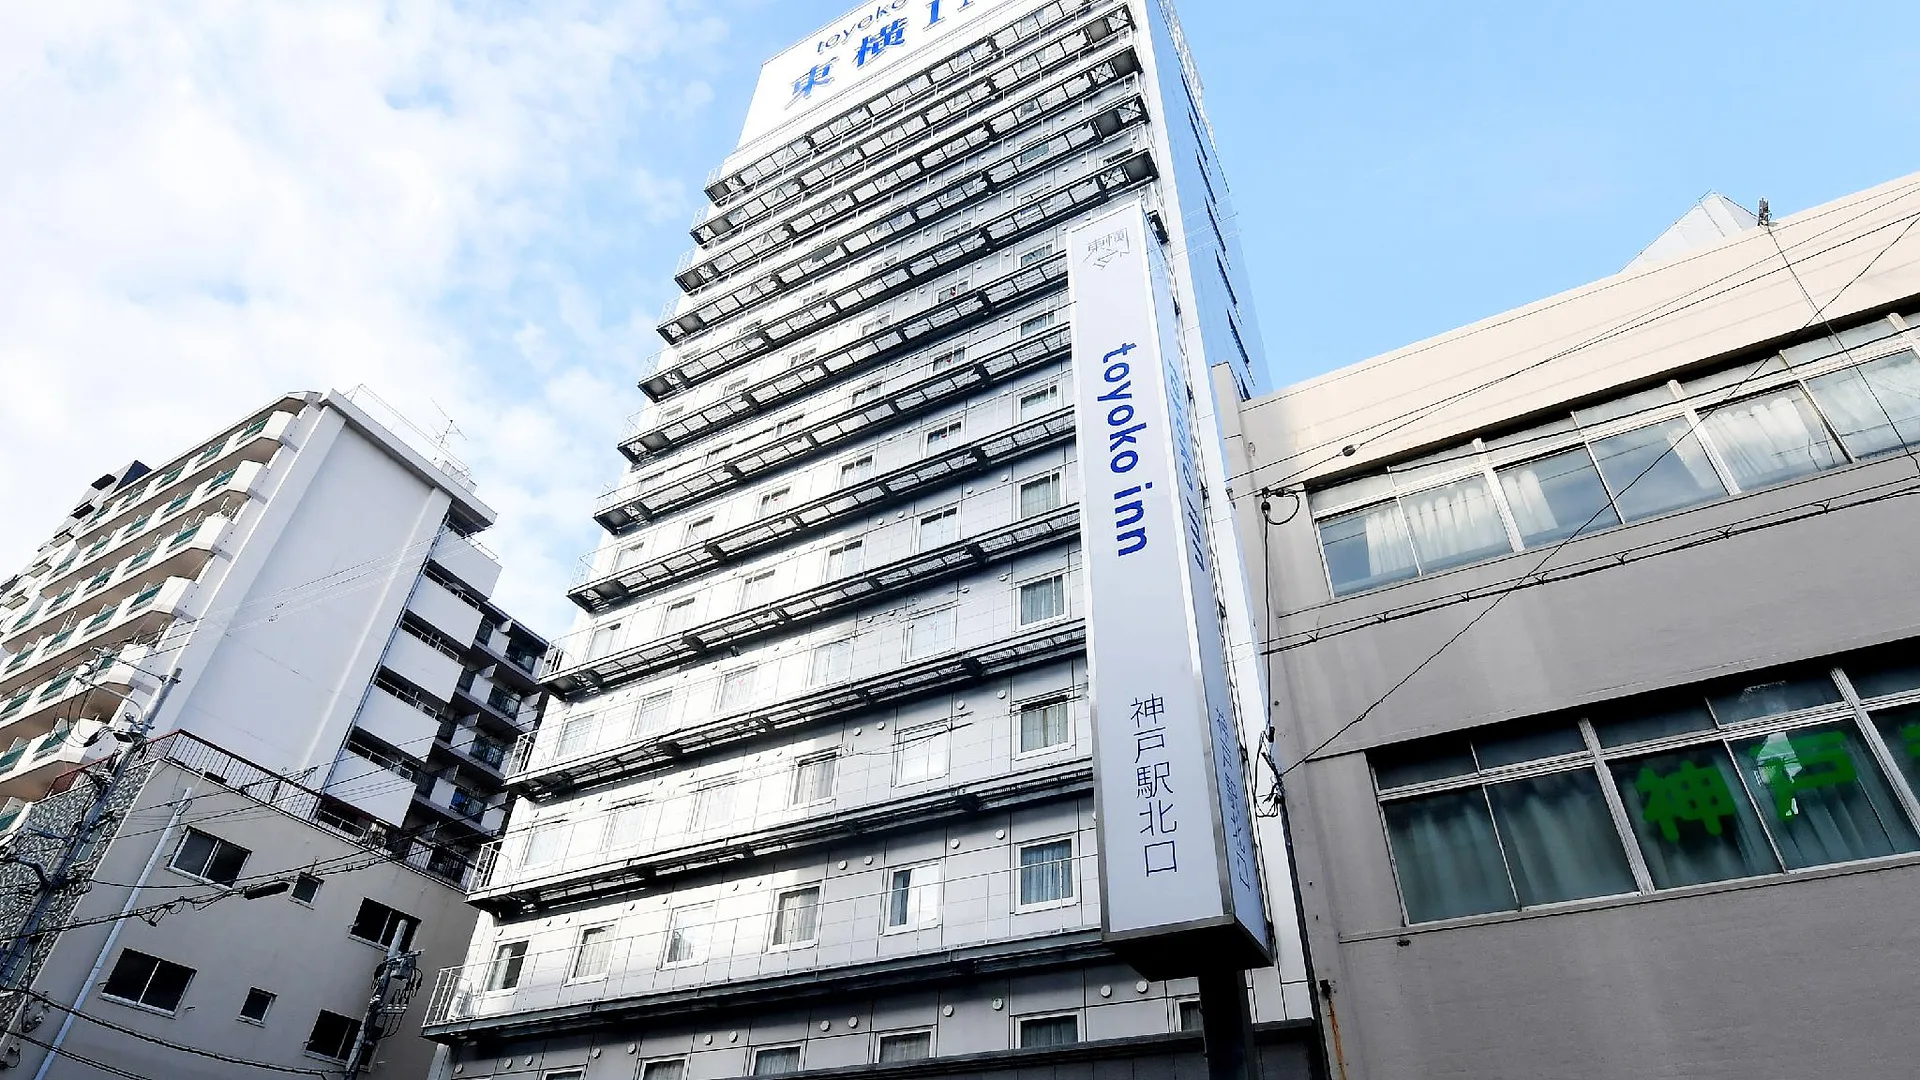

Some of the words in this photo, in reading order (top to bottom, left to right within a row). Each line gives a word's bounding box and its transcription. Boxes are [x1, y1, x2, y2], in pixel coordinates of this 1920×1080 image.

[785, 0, 974, 110] 東横I
[1097, 342, 1148, 474] toyoko
[1113, 481, 1153, 557] inn
[1130, 692, 1177, 877] 神戸駅北口
[1634, 723, 1920, 842] 神戸
